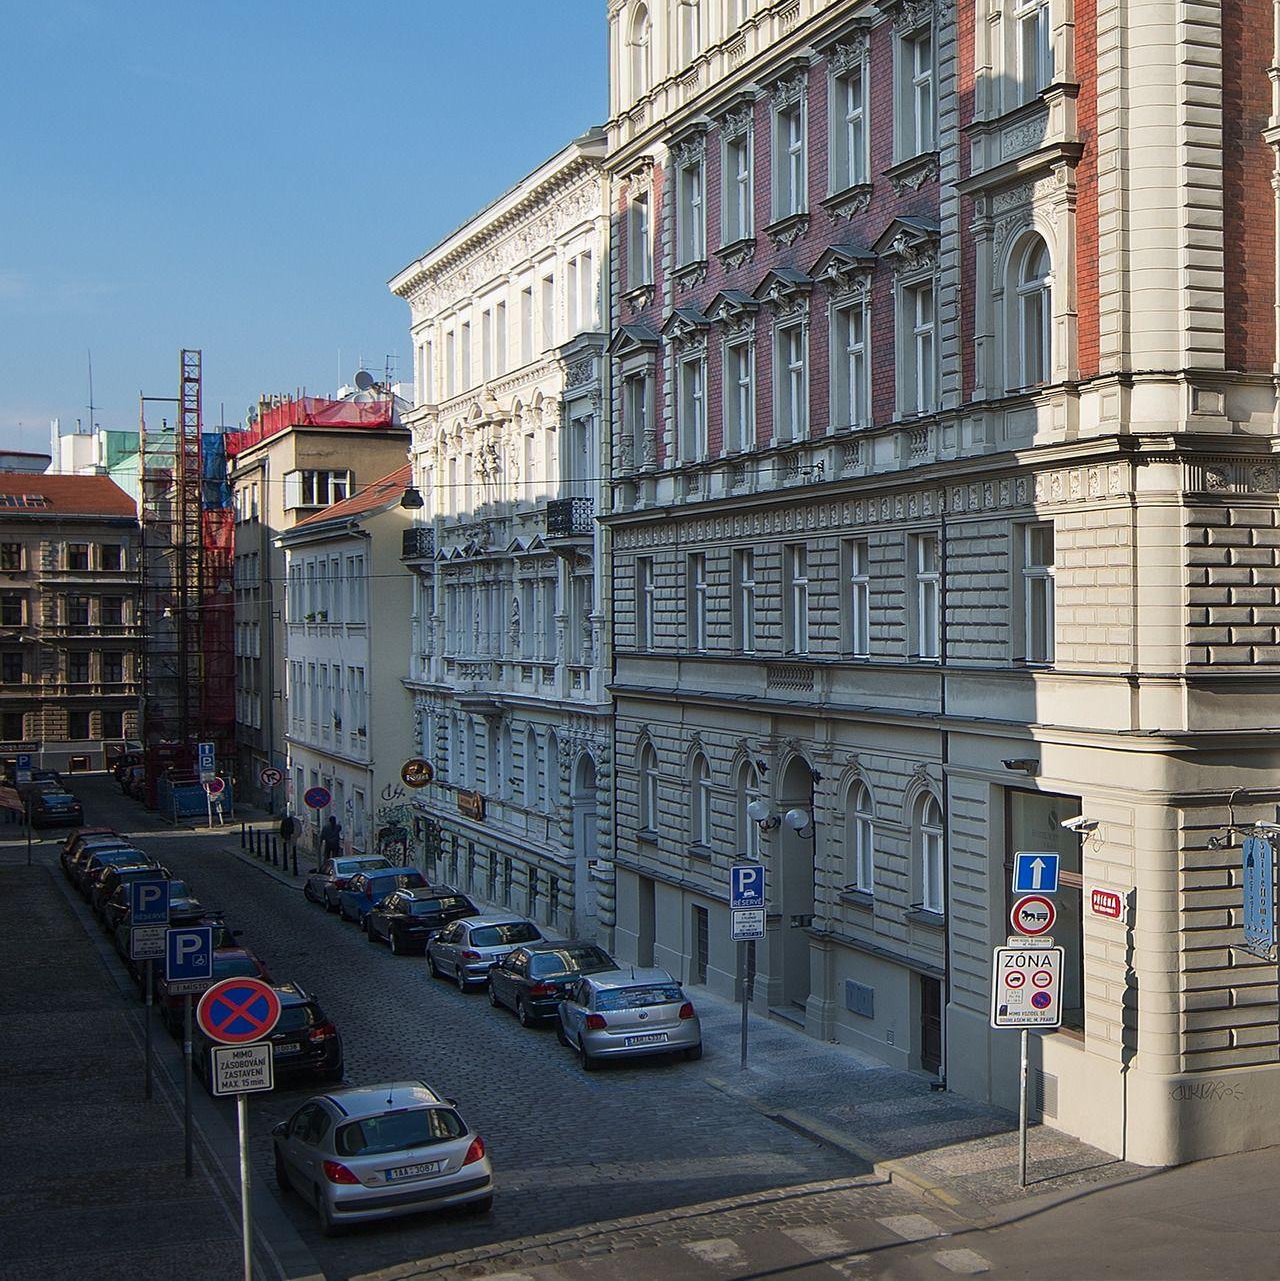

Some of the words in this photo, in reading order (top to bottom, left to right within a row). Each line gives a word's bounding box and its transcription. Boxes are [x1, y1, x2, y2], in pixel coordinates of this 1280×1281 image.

[739, 868, 757, 893] P
[139, 885, 162, 911] P
[176, 933, 203, 965] P
[1004, 951, 1053, 968] ZÓNA
[232, 1050, 253, 1059] MIMO
[220, 1057, 266, 1070] ZÁSOBOVÁNÍ
[224, 1067, 263, 1079] ZASTAVENÍ
[221, 1080, 241, 1089] MAX.
